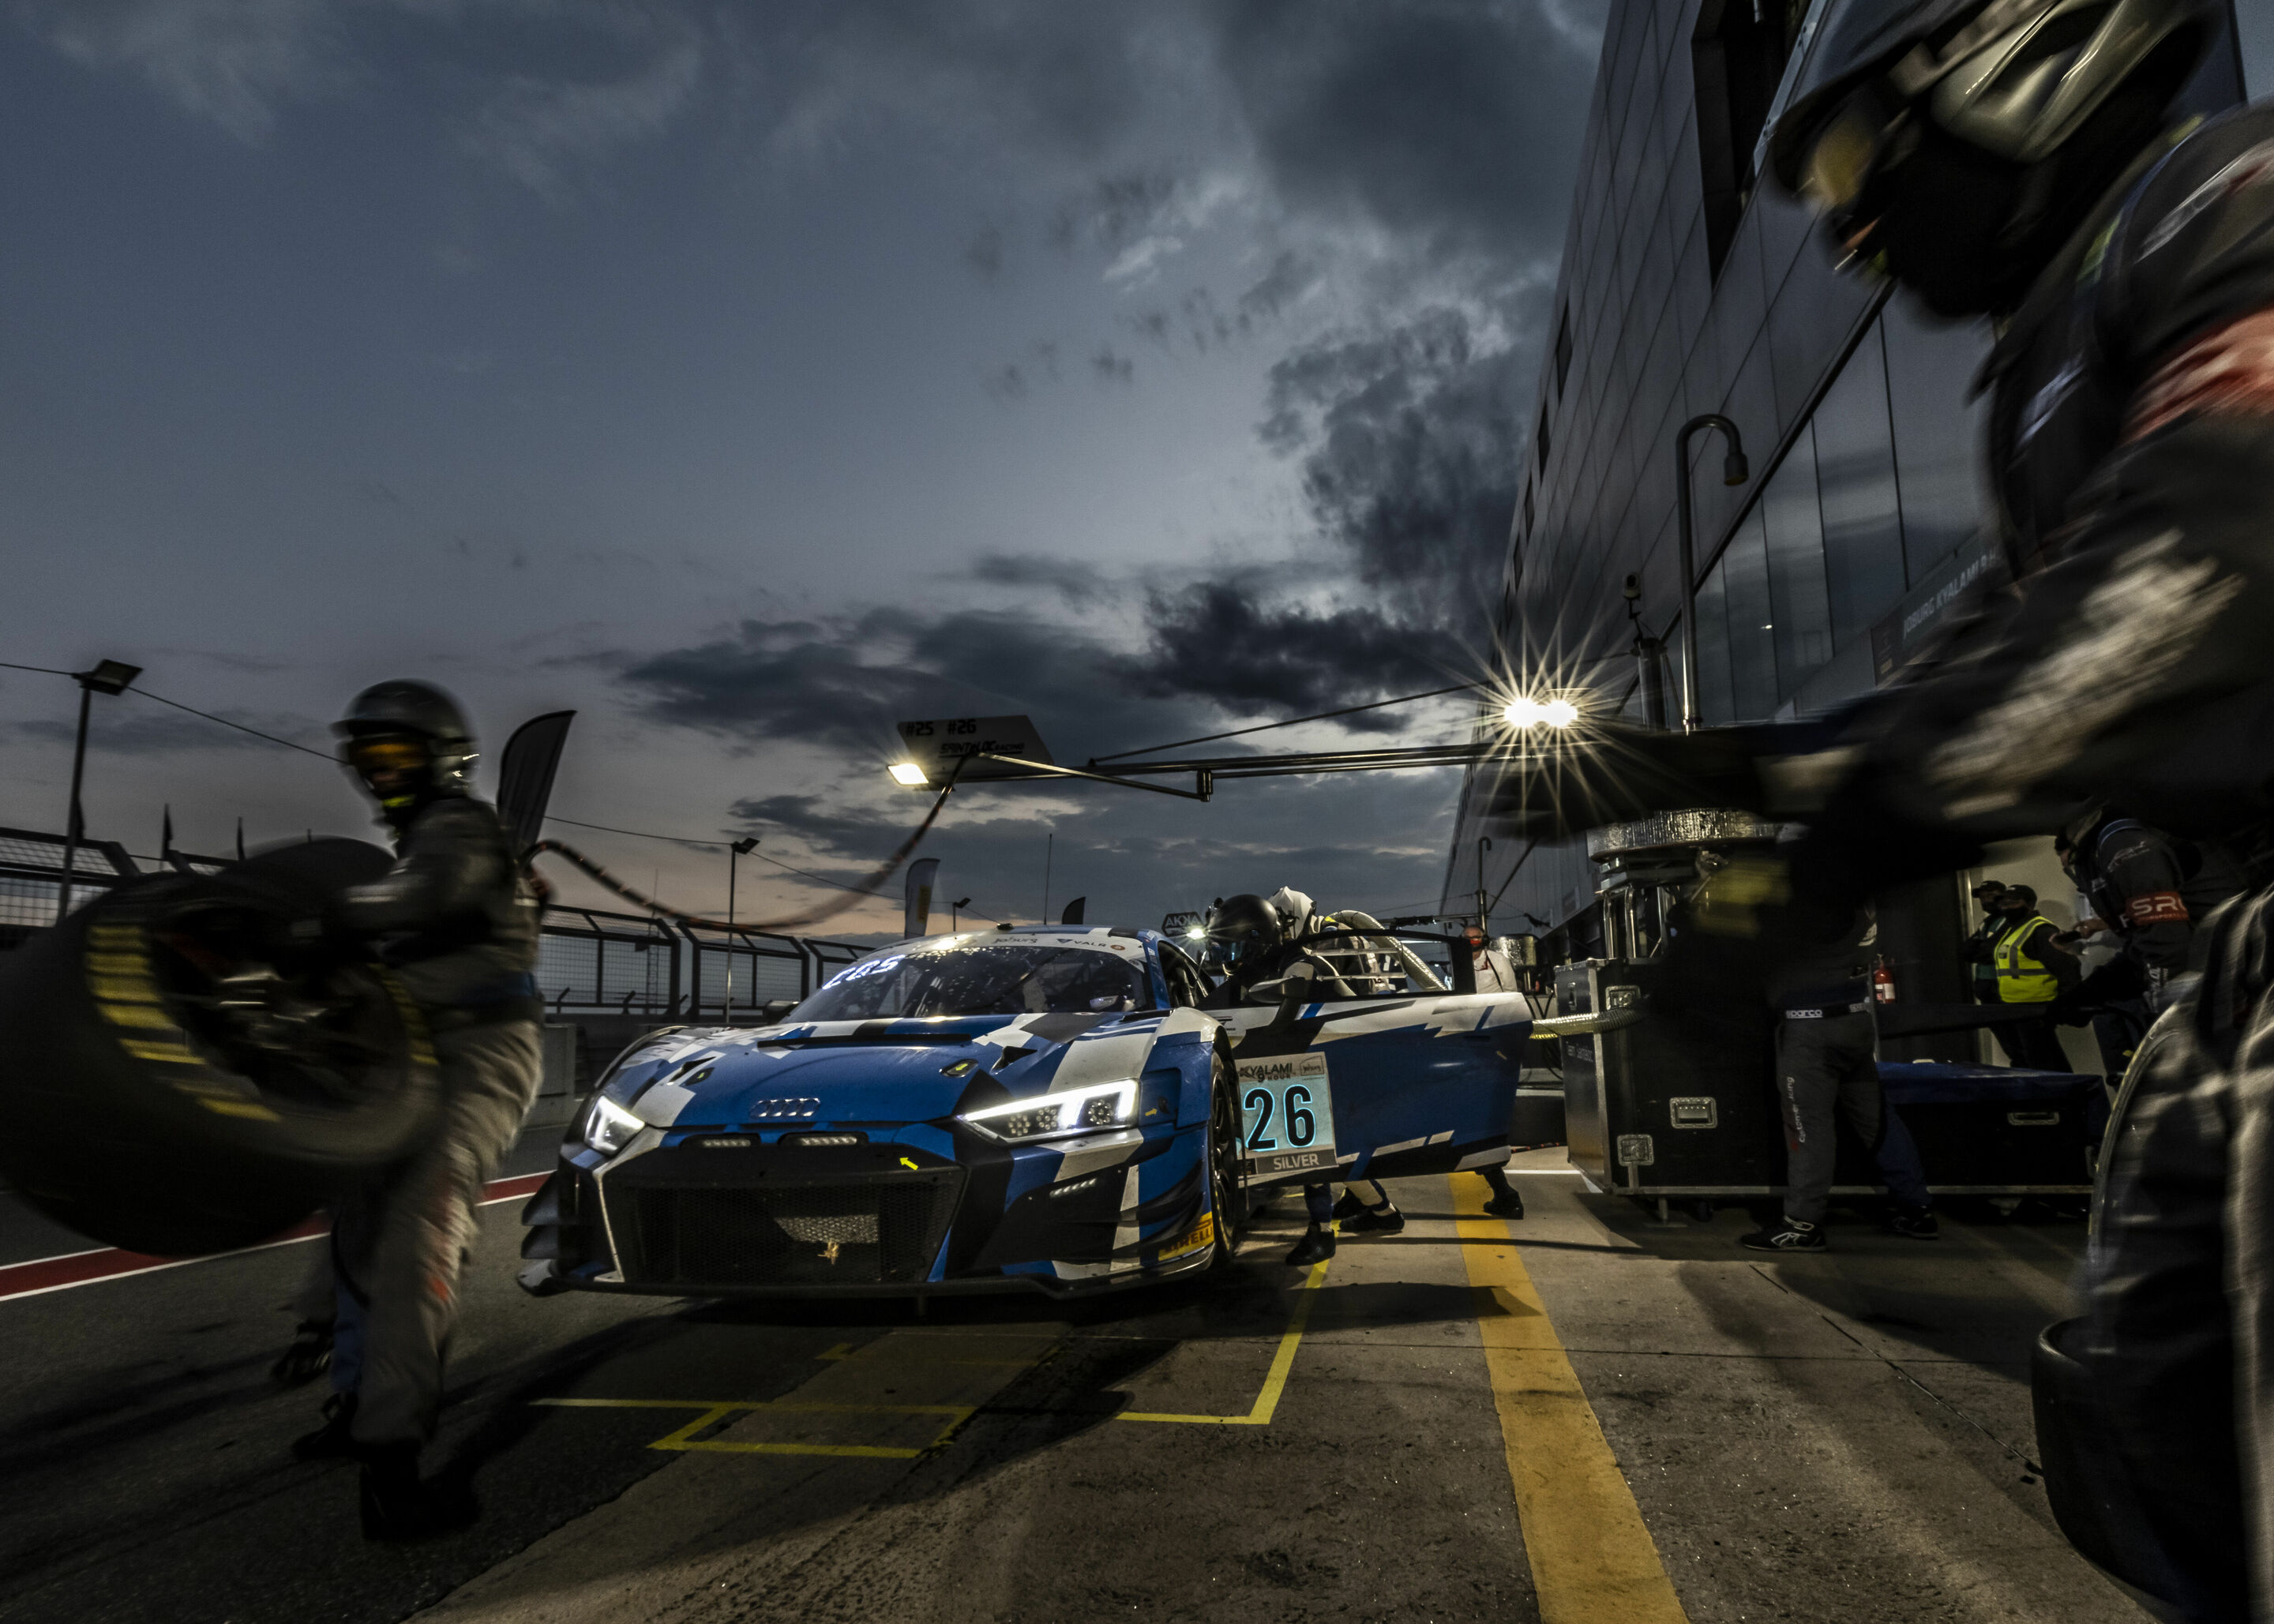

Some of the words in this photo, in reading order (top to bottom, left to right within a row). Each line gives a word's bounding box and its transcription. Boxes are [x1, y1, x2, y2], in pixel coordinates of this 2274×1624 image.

[906, 722, 933, 736] #25
[948, 718, 976, 734] #26
[1240, 1063, 1293, 1079] KYALAMI
[1258, 1074, 1266, 1082] 9
[1244, 1084, 1315, 1151] 26
[1273, 1153, 1319, 1170] SILVER
